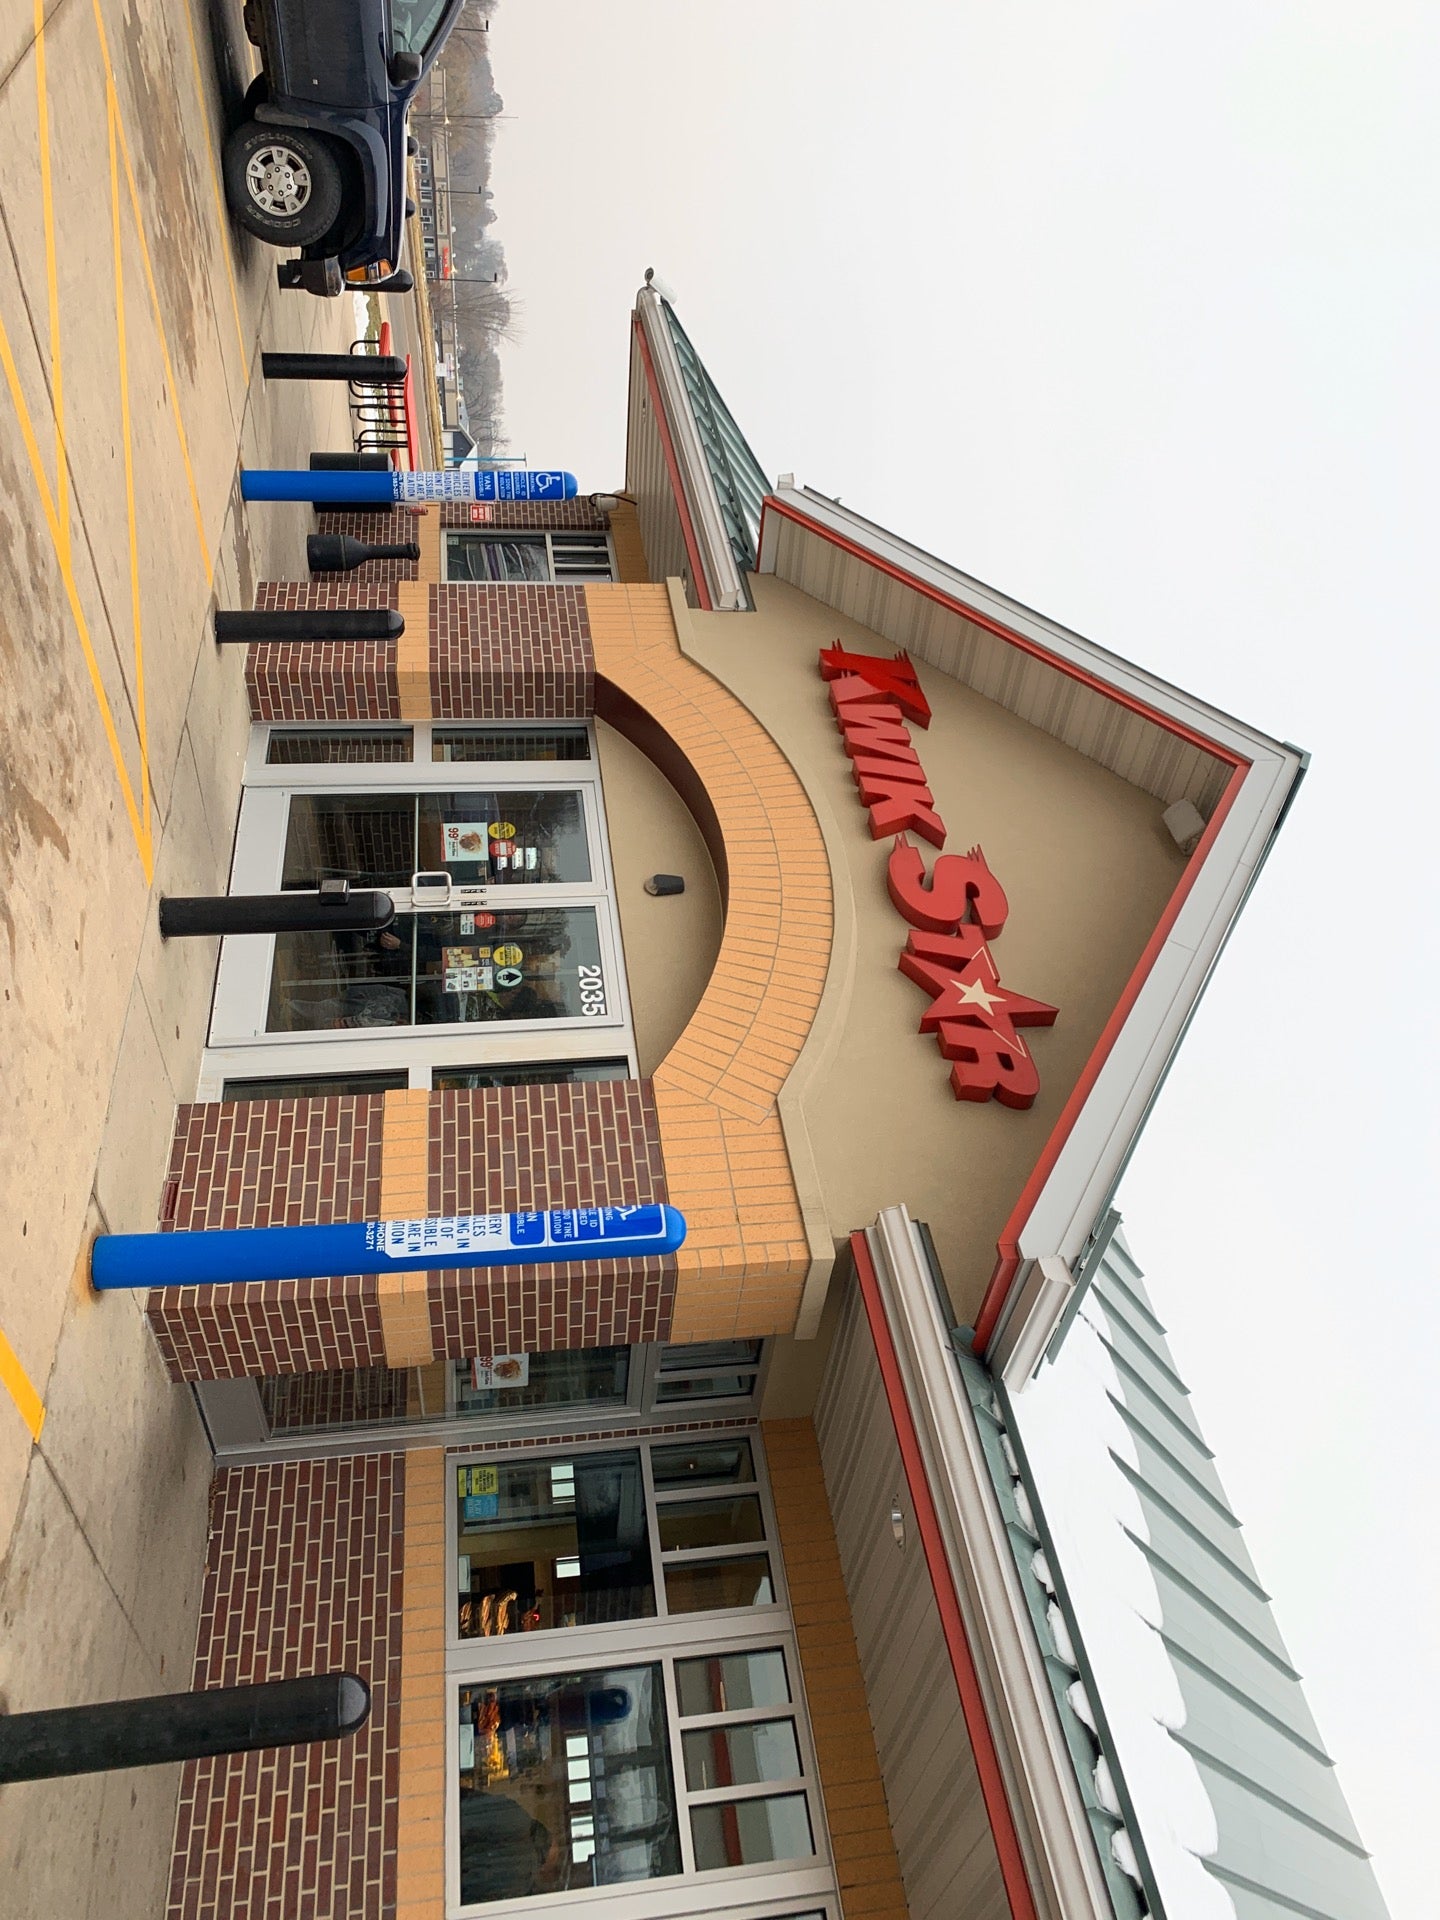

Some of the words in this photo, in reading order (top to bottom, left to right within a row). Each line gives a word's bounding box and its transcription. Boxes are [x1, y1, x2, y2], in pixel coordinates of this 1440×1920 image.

[434, 473, 442, 486] RONT
[484, 475, 492, 490] VAN
[818, 638, 947, 850] KWIK
[578, 964, 606, 1016] 2035
[526, 1212, 538, 1222] AN
[590, 1220, 597, 1228] ID
[391, 1220, 405, 1244] ATION
[408, 1224, 421, 1238] ARE
[440, 1227, 454, 1238] OF
[456, 1217, 470, 1234] DING
[472, 1217, 486, 1236] CLES
[489, 1215, 502, 1235] VERY
[564, 1222, 572, 1238] FINE
[376, 1223, 386, 1252] PHONE
[456, 1238, 470, 1248] IN
[408, 1242, 421, 1252] IN
